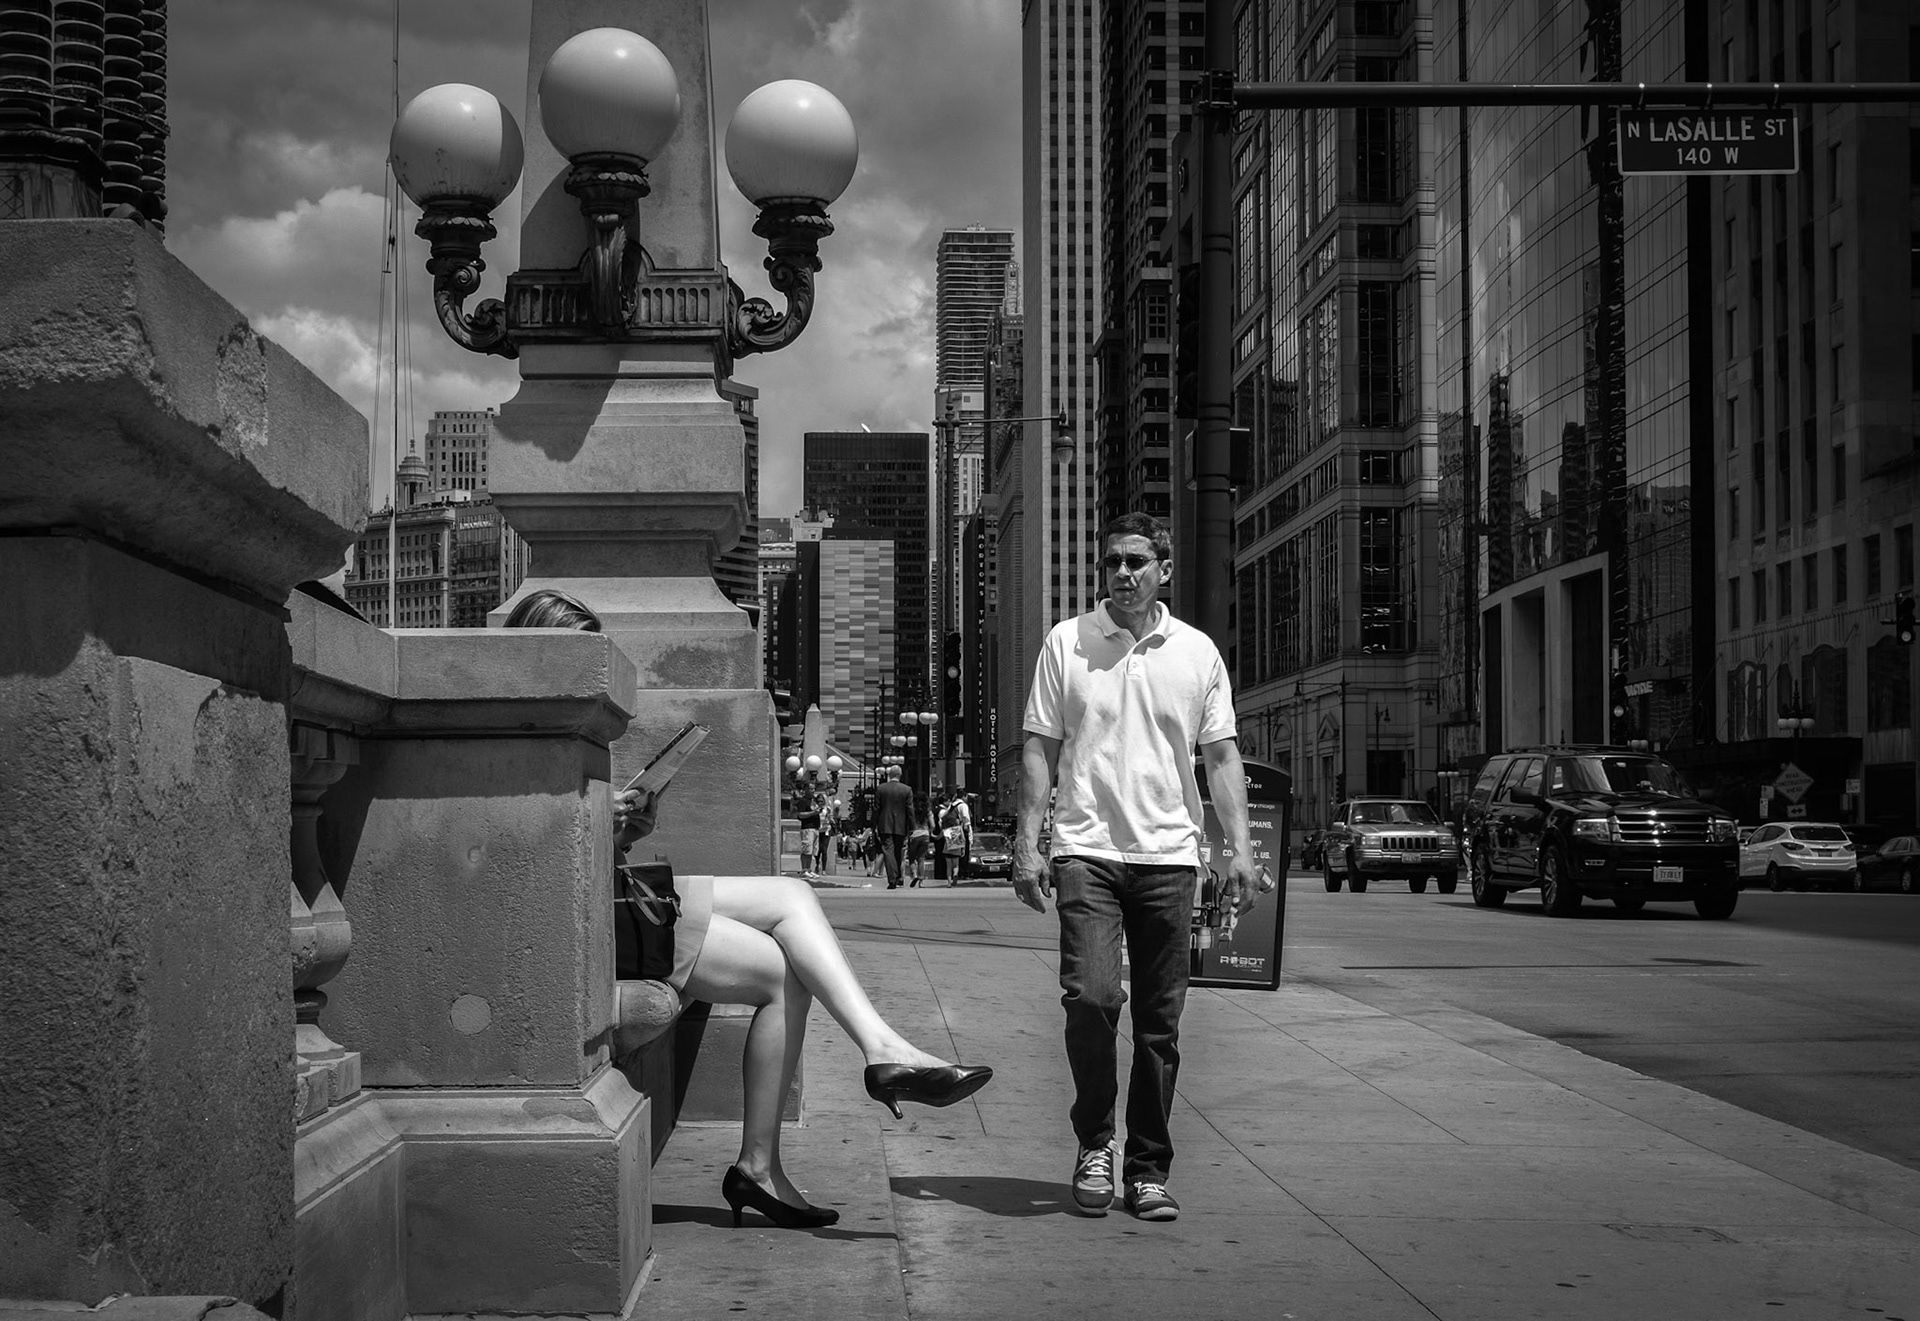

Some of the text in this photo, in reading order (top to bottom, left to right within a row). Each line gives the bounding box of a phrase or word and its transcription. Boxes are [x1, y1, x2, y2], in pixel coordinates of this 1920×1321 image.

[1627, 121, 1640, 138] N
[1764, 119, 1786, 136] ST
[1677, 147, 1739, 165] 140 W
[1248, 820, 1273, 830] UMANS,
